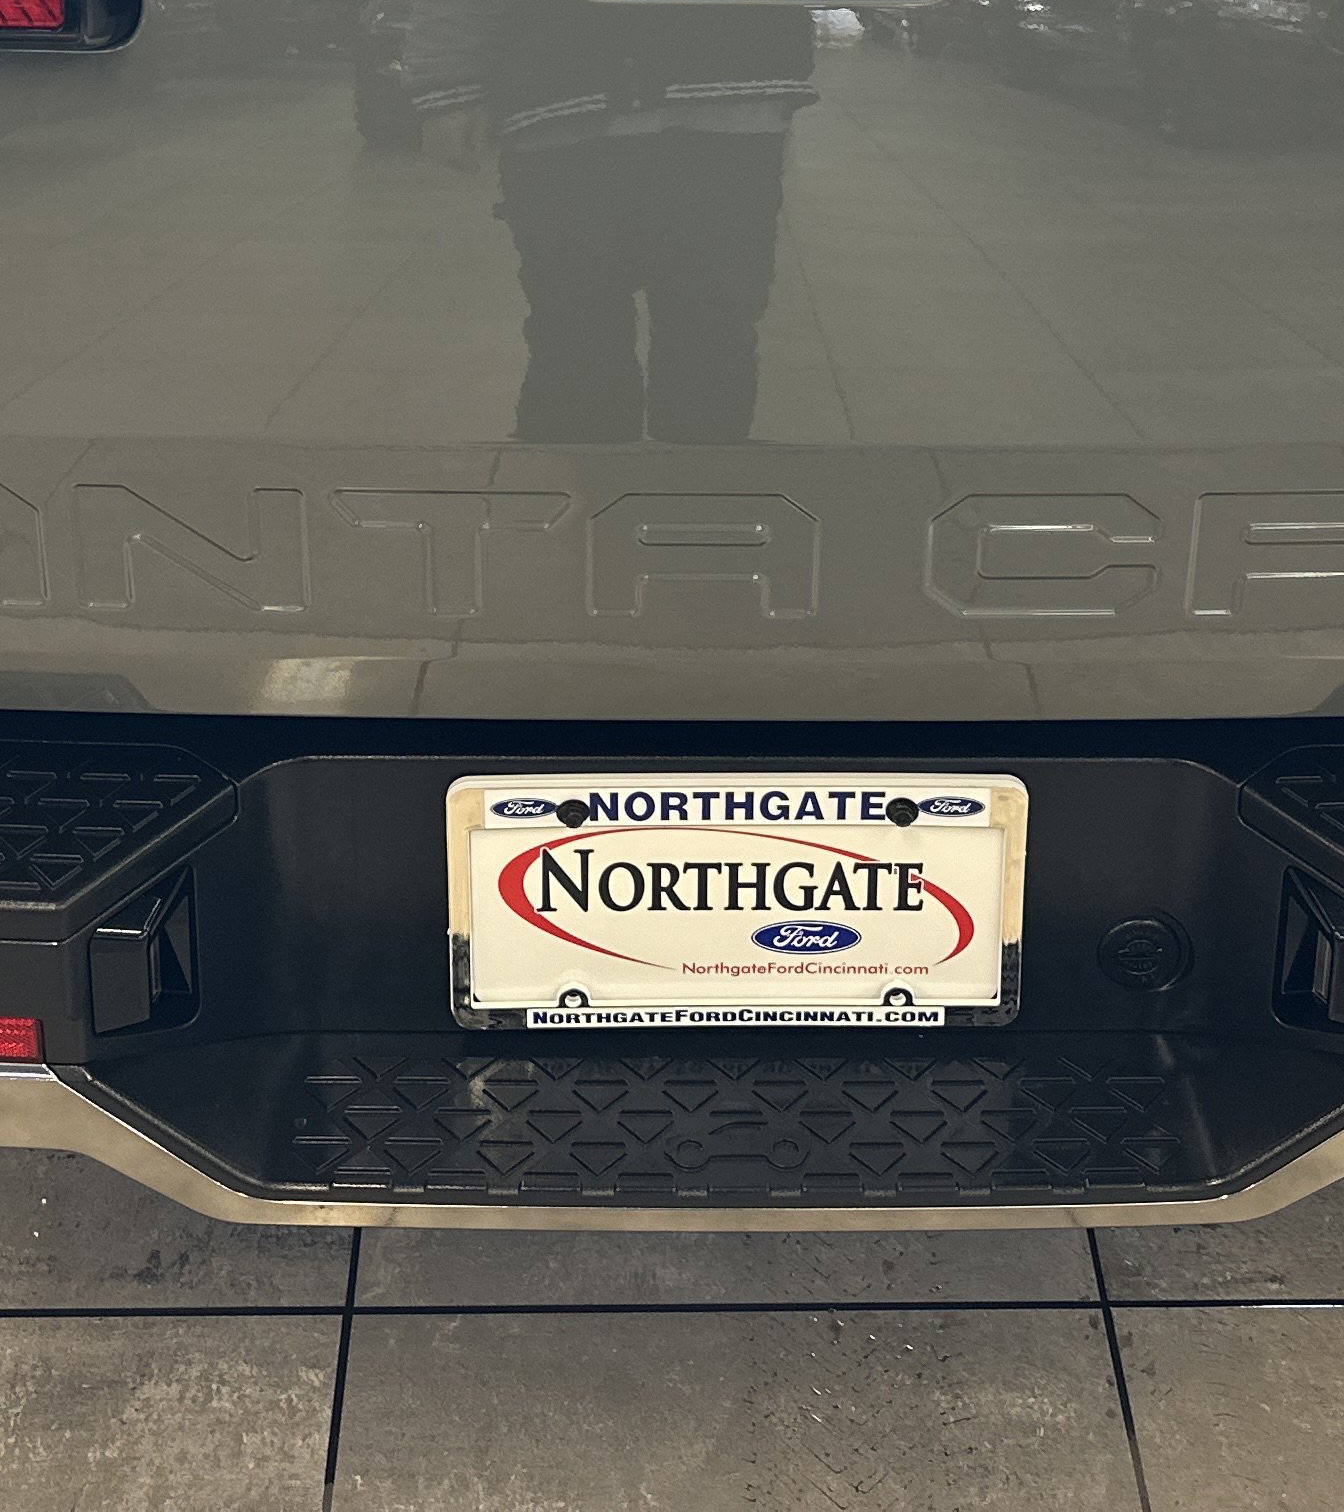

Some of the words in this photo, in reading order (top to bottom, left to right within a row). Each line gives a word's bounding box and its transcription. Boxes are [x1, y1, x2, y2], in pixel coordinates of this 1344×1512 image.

[589, 791, 887, 822] NORTHGATE
[537, 848, 925, 913] NORTHGATE
[773, 924, 841, 949] Ford
[682, 961, 929, 976] NorthgateFordCincinnati.com
